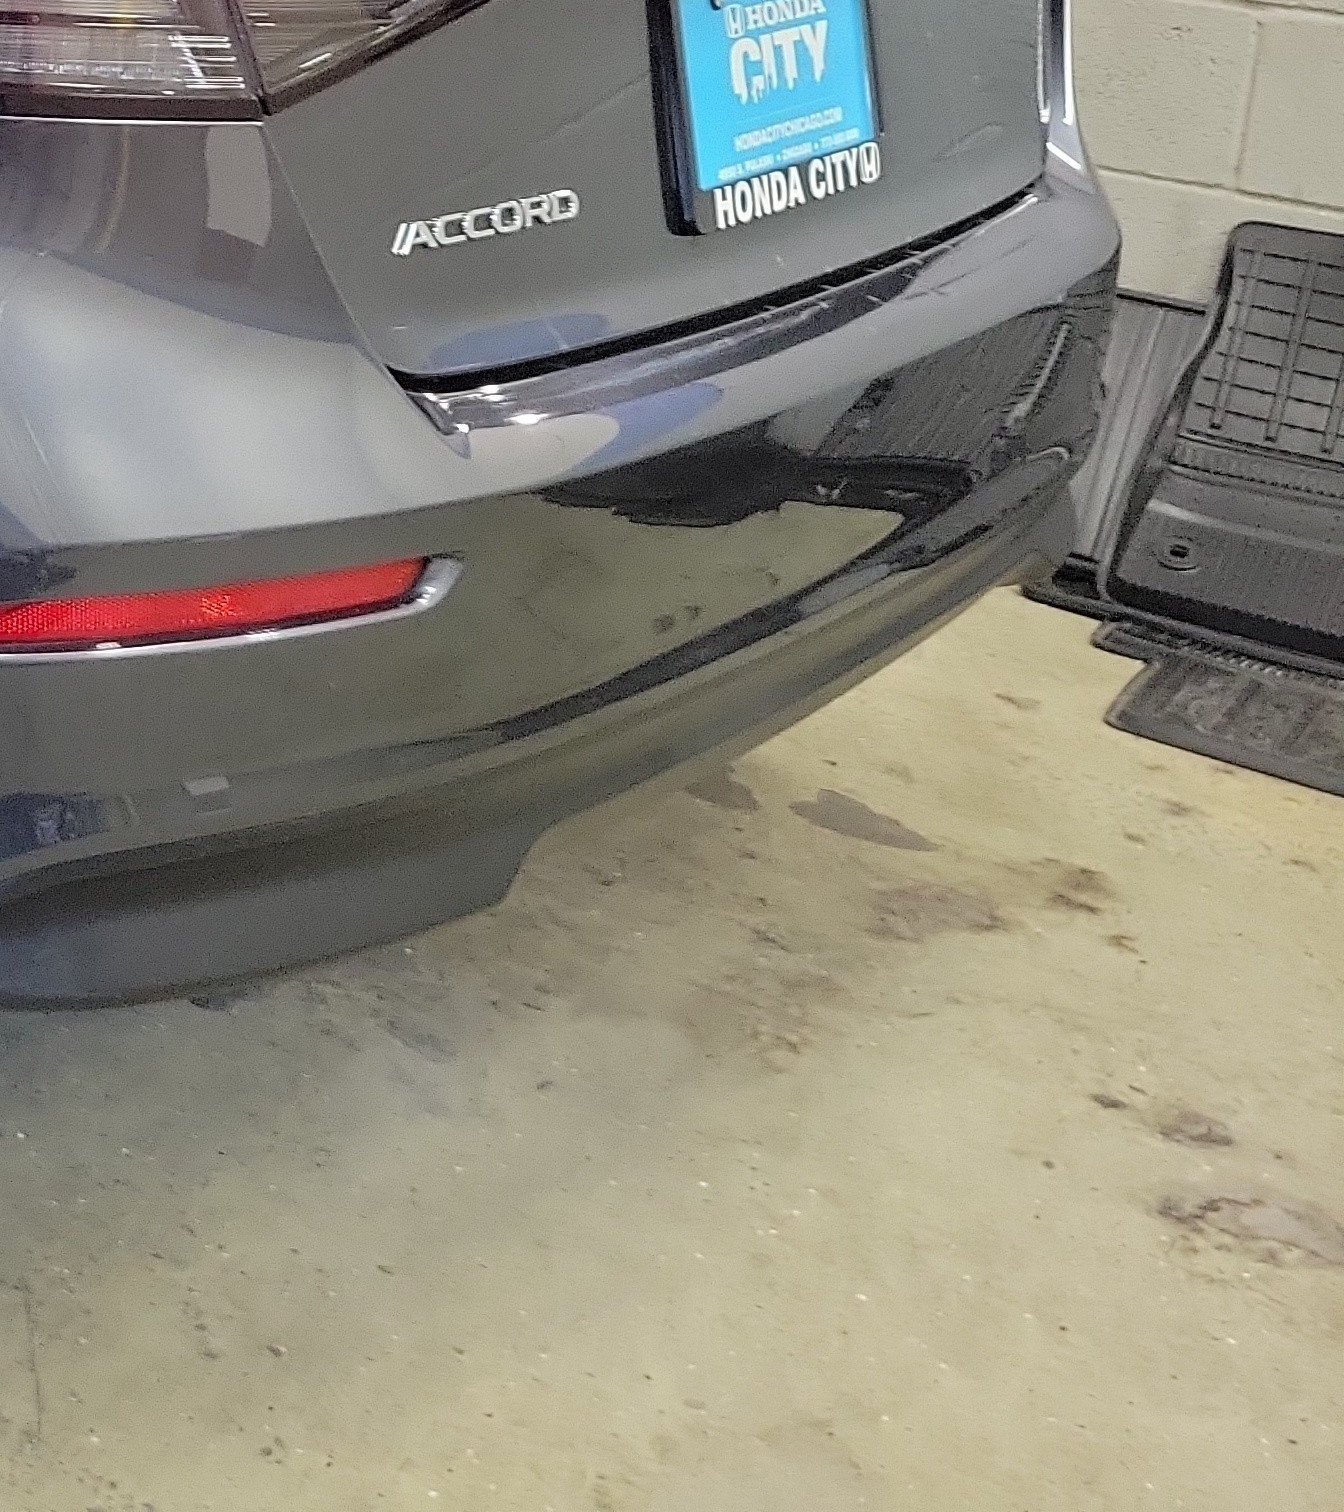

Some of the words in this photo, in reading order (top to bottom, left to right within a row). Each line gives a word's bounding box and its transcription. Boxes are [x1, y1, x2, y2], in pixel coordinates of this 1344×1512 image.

[729, 19, 828, 105] CITY
[391, 189, 580, 255] ACCORD
[713, 165, 806, 229] HONDA
[808, 147, 858, 200] CITY
